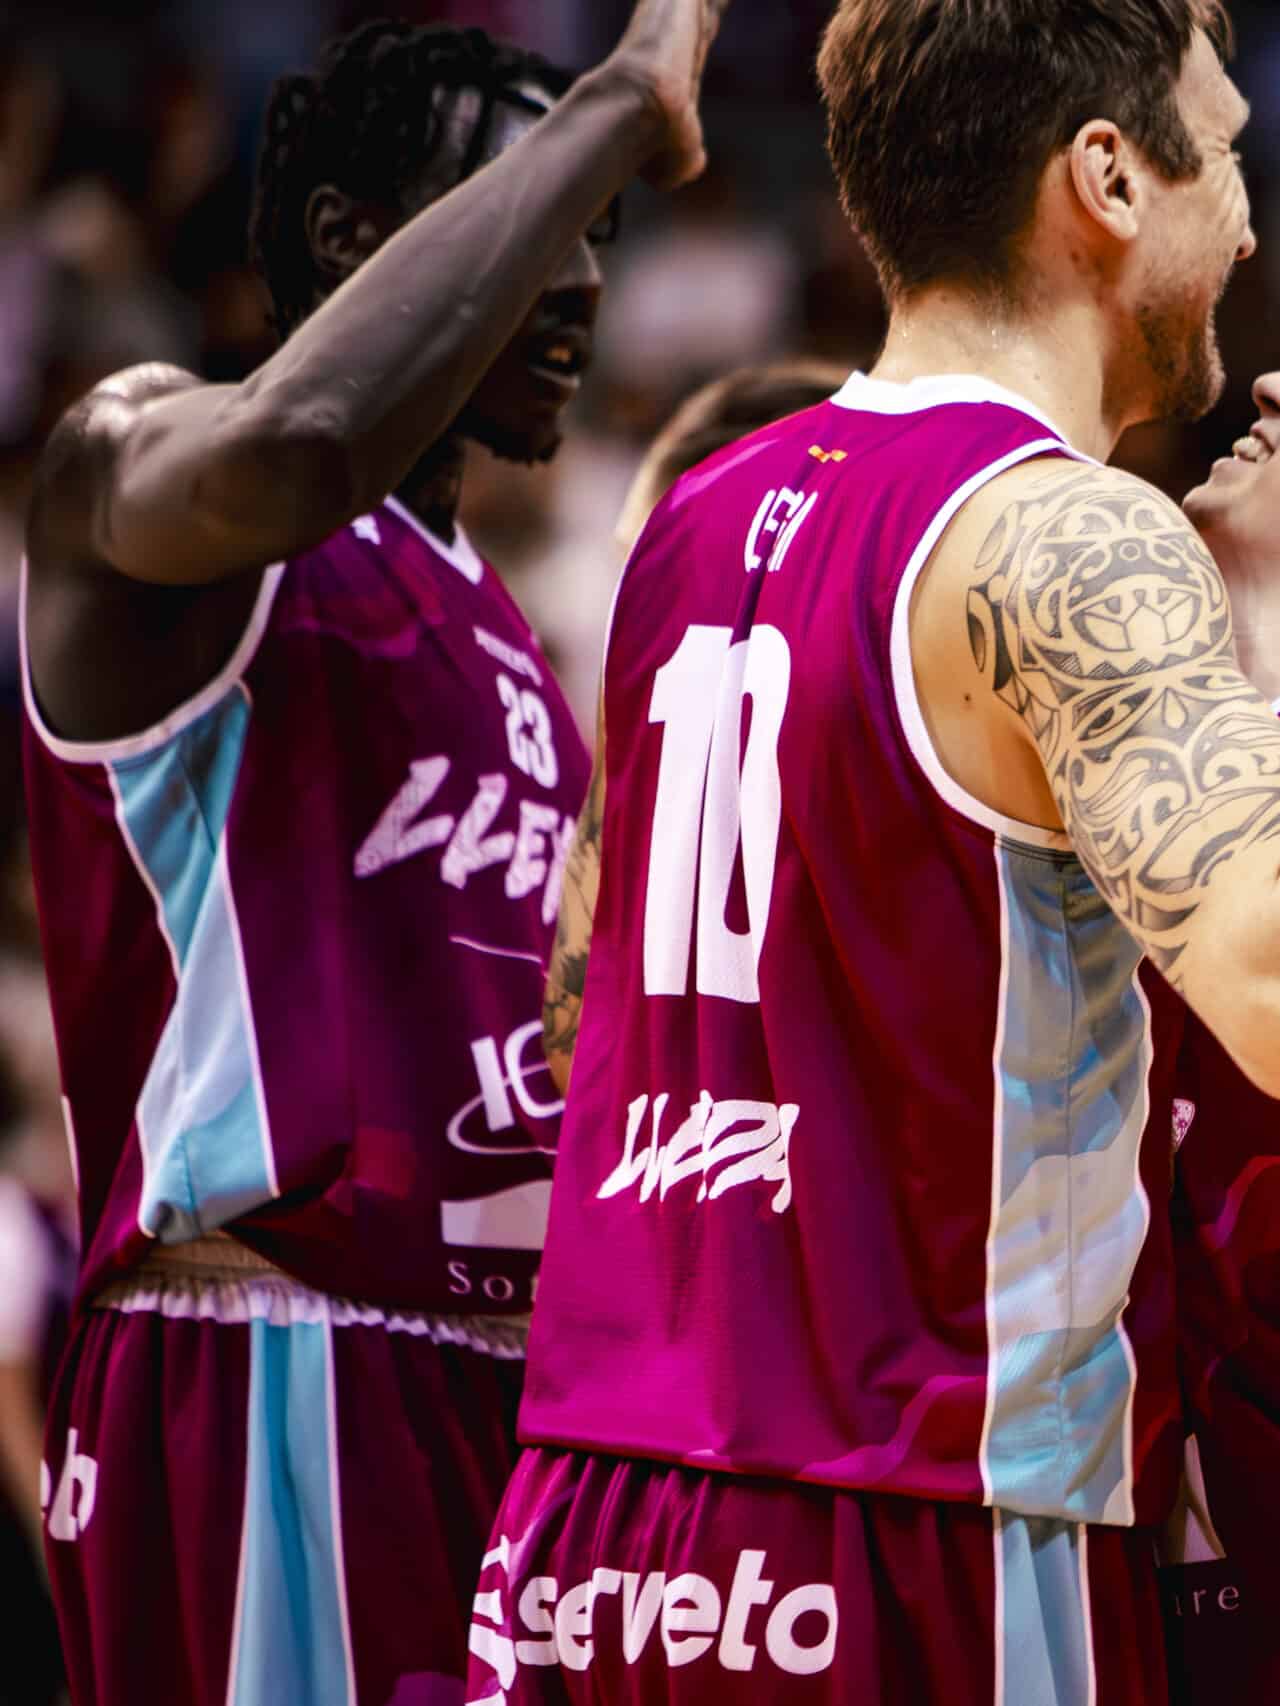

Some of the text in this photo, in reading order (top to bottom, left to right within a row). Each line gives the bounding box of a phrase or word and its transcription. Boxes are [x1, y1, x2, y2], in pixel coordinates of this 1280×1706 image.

[495, 672, 559, 789] 23
[352, 754, 577, 925] LLEI
[643, 623, 792, 1004] 10
[514, 1548, 840, 1676] serveto
